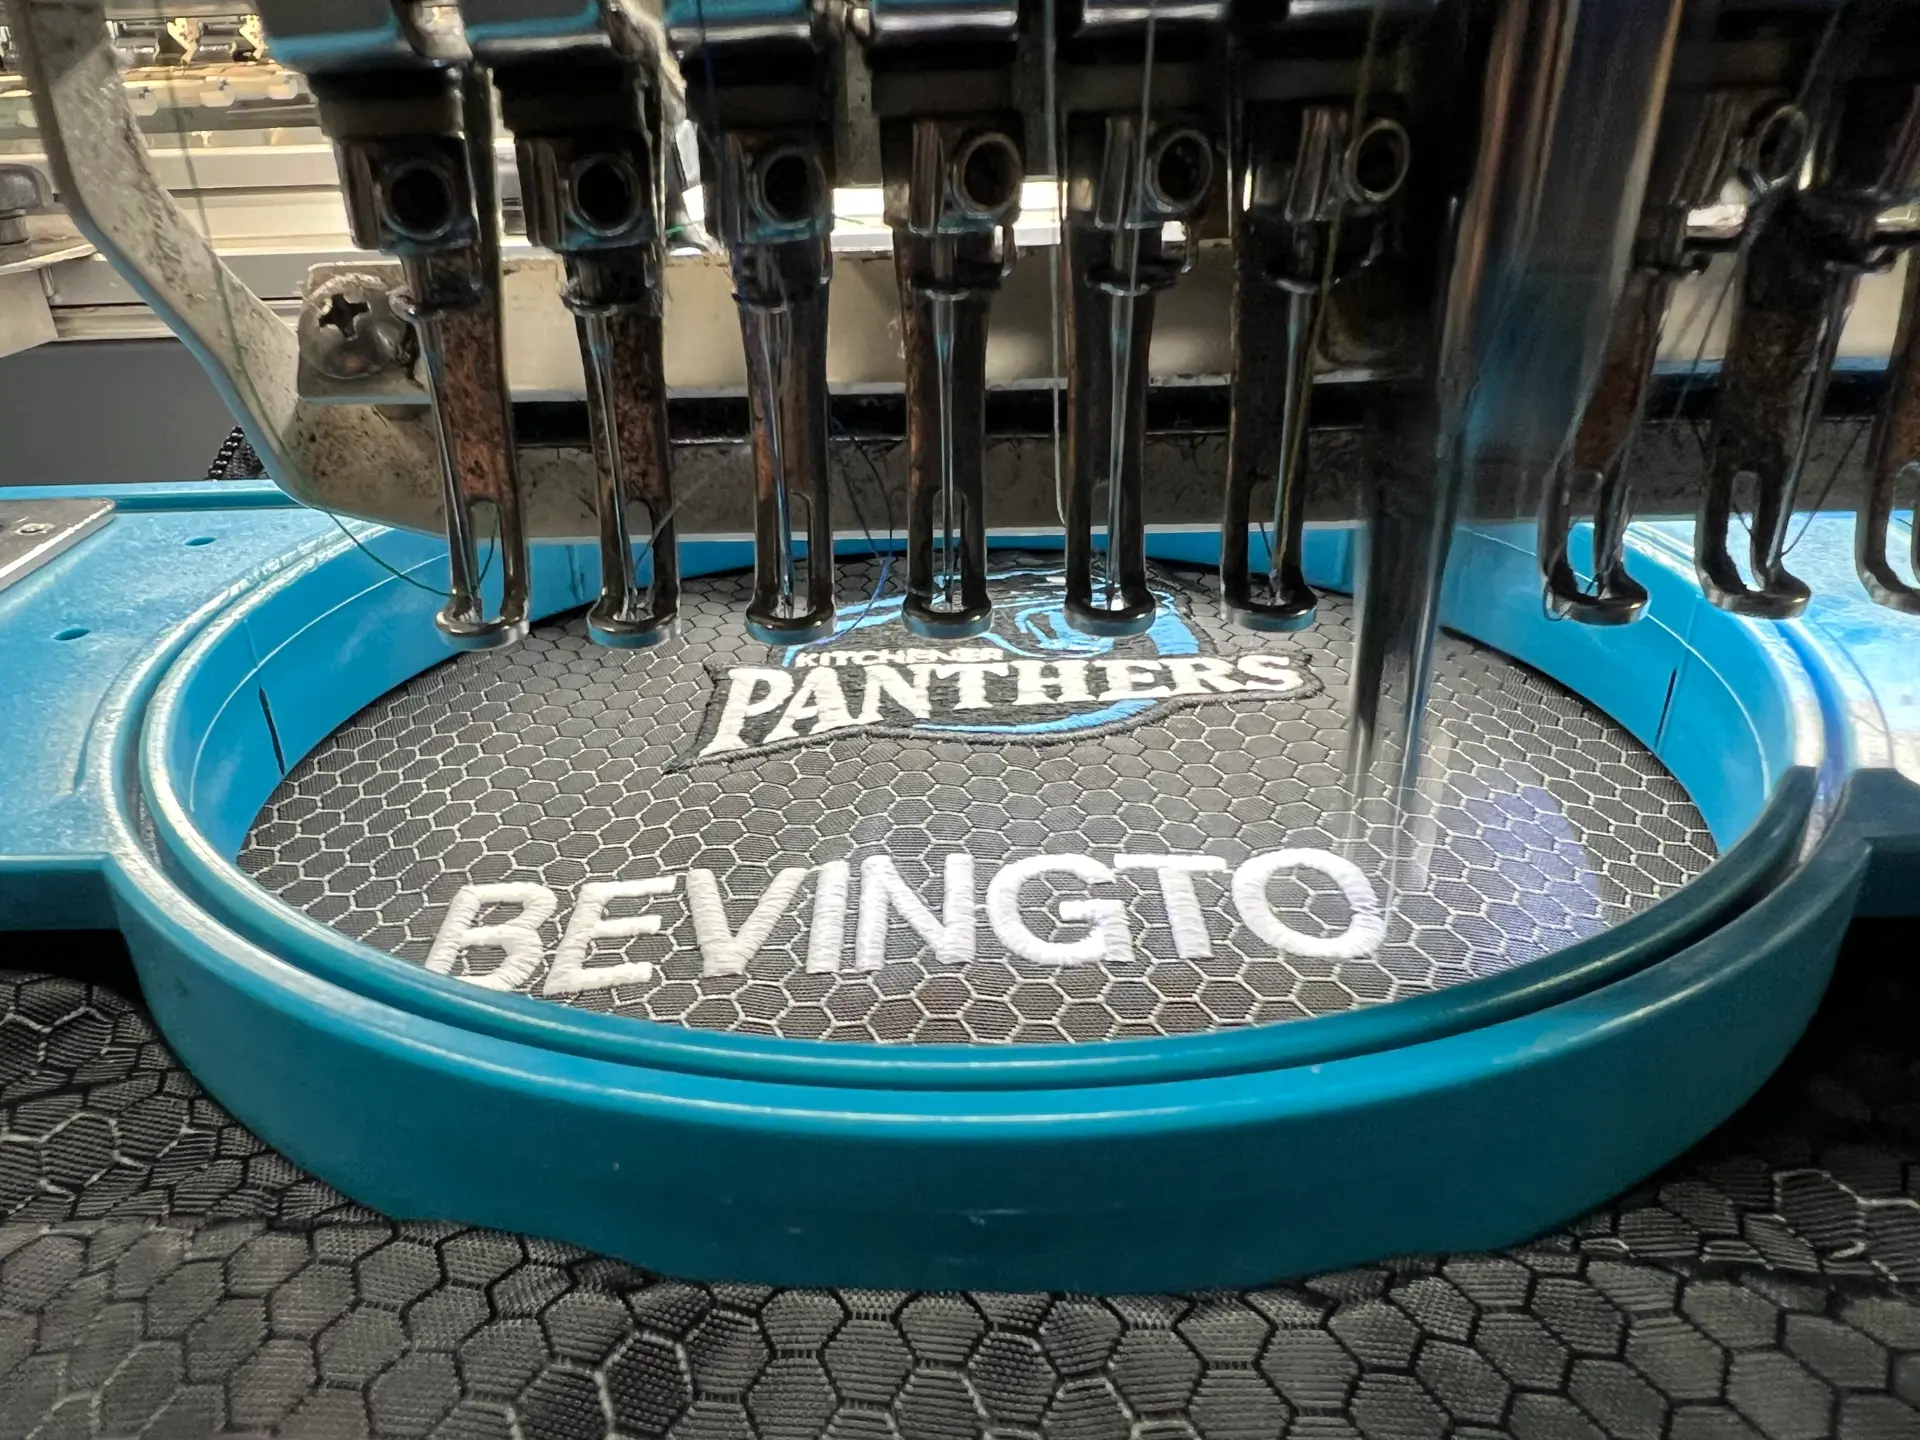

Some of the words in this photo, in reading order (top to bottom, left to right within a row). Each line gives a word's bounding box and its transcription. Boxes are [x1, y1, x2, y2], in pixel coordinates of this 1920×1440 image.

[698, 654, 1304, 757] PANTHERS
[795, 648, 1005, 668] KITCHENER
[424, 847, 1387, 994] BEVINGTO
